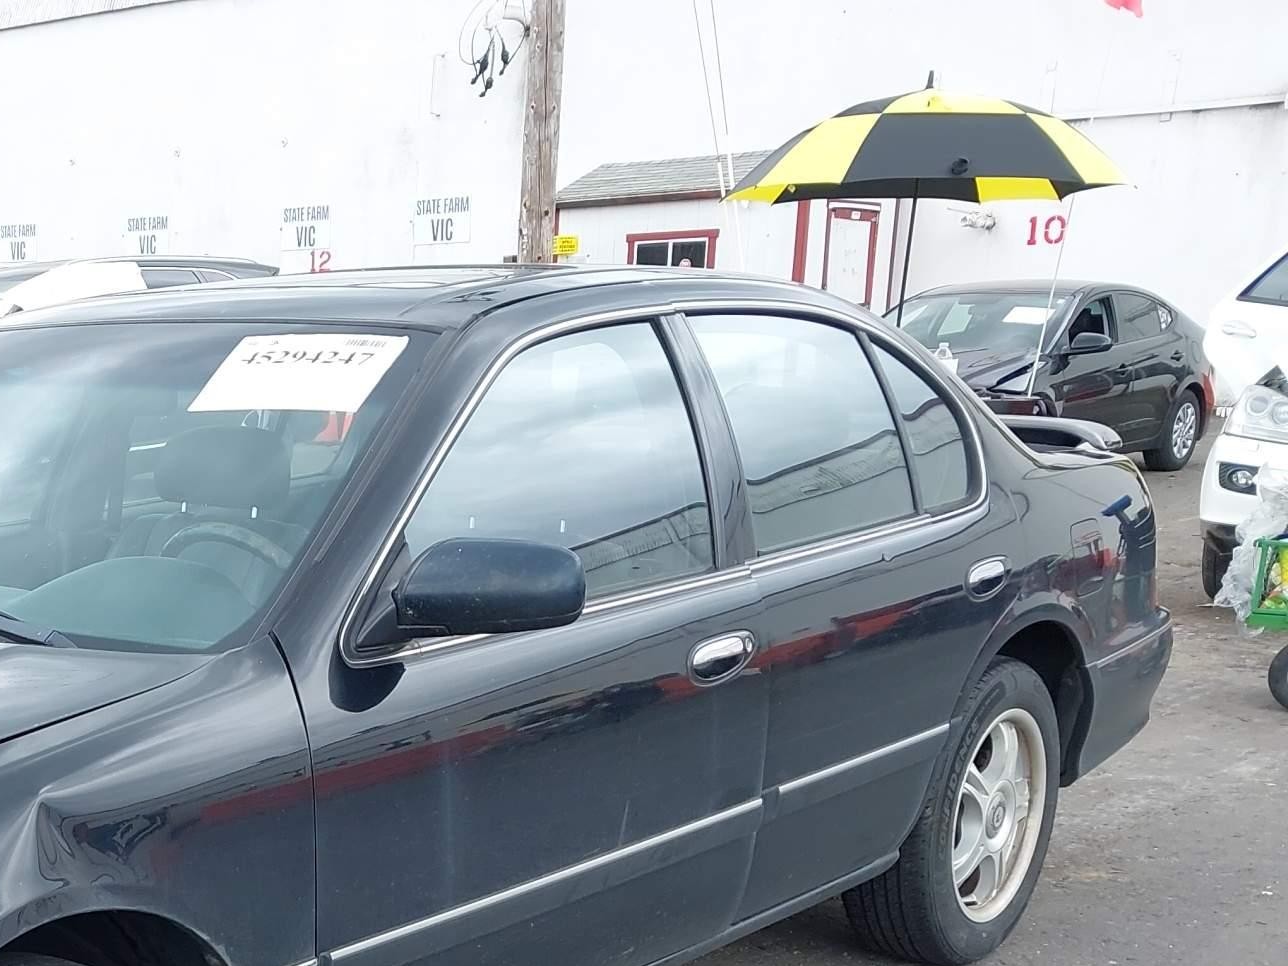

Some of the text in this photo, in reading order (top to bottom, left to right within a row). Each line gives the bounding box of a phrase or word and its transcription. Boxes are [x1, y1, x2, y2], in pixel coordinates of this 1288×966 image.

[283, 205, 330, 223] STATE FARM
[417, 196, 470, 216] STATE FARM
[0, 224, 36, 239] STATE FARM
[127, 216, 168, 232] STATE FARM
[431, 218, 453, 241] VIC
[1027, 215, 1066, 245] 10
[139, 234, 156, 254] VIC
[296, 225, 316, 247] VIC
[10, 241, 26, 260] VIC
[310, 250, 331, 272] 12
[241, 351, 375, 366] 45294247
